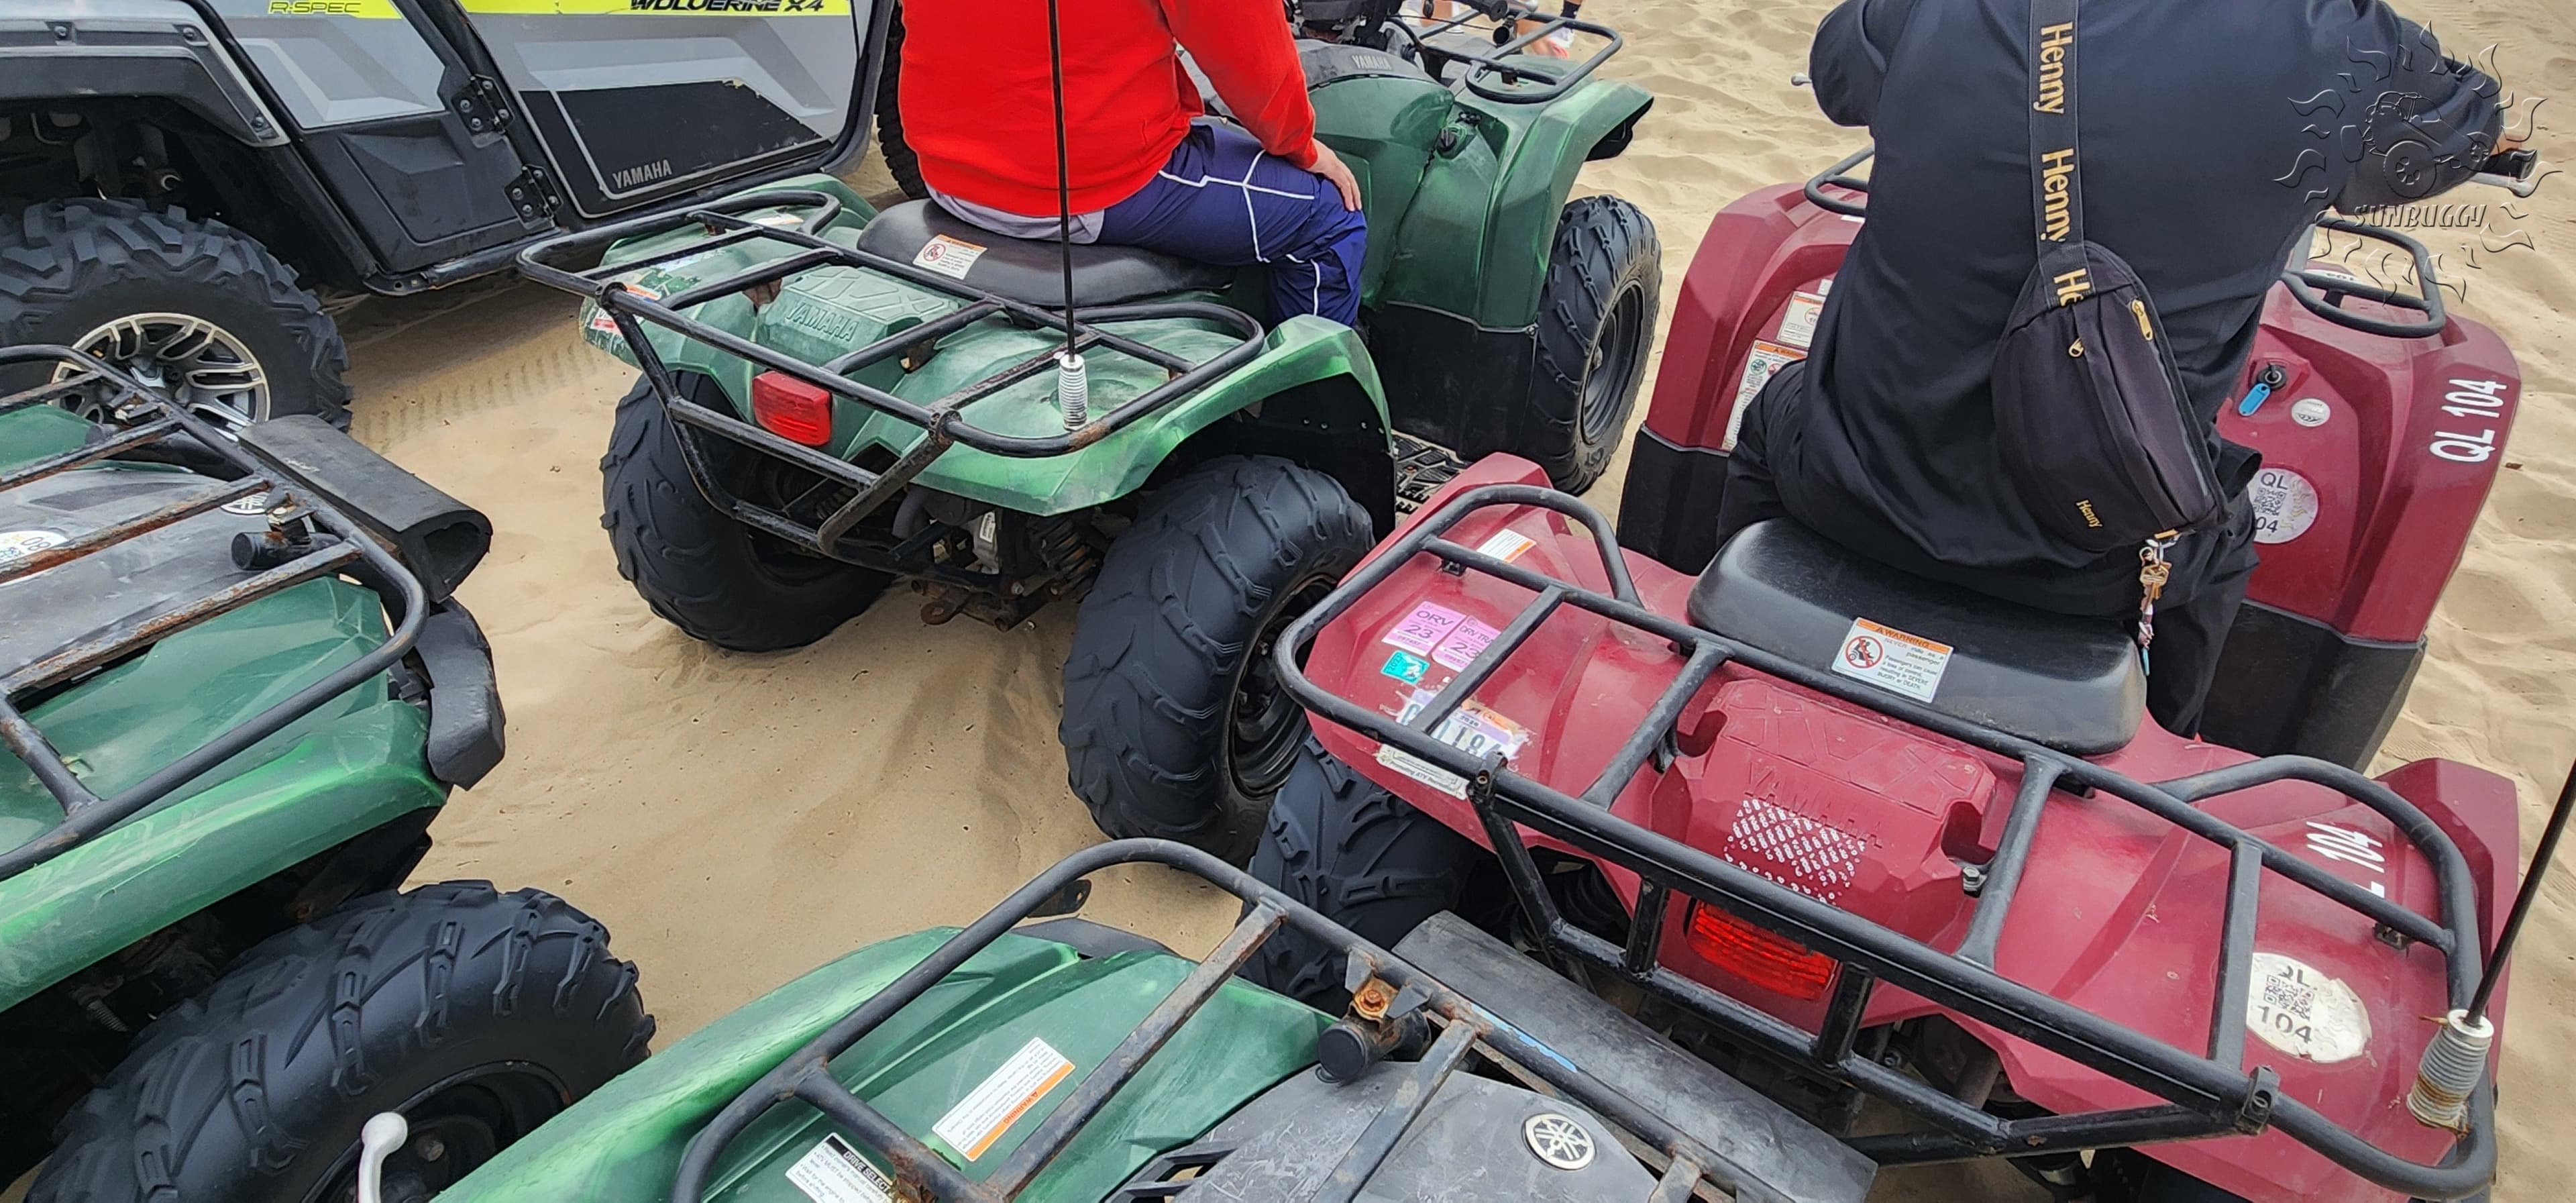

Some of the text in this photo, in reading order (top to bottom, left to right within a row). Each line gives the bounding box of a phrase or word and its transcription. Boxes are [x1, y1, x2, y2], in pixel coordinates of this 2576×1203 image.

[782, 0, 824, 11] X4
[1351, 54, 1393, 71] YAMAHA
[2033, 21, 2074, 115] Henny
[612, 159, 673, 189] YAMAHA
[784, 301, 859, 343] YAMAHA
[2429, 379, 2508, 462] QL 104
[2260, 472, 2289, 490] QL
[2076, 499, 2104, 527] Henny
[1404, 624, 1435, 639] 23
[1416, 610, 1454, 626] ORV
[1450, 641, 1481, 659] 23
[1885, 629, 1930, 649] WARNING
[2306, 821, 2385, 874] 104
[2257, 1005, 2312, 1044] 104
[843, 1151, 891, 1193] DRIVE SELECT
